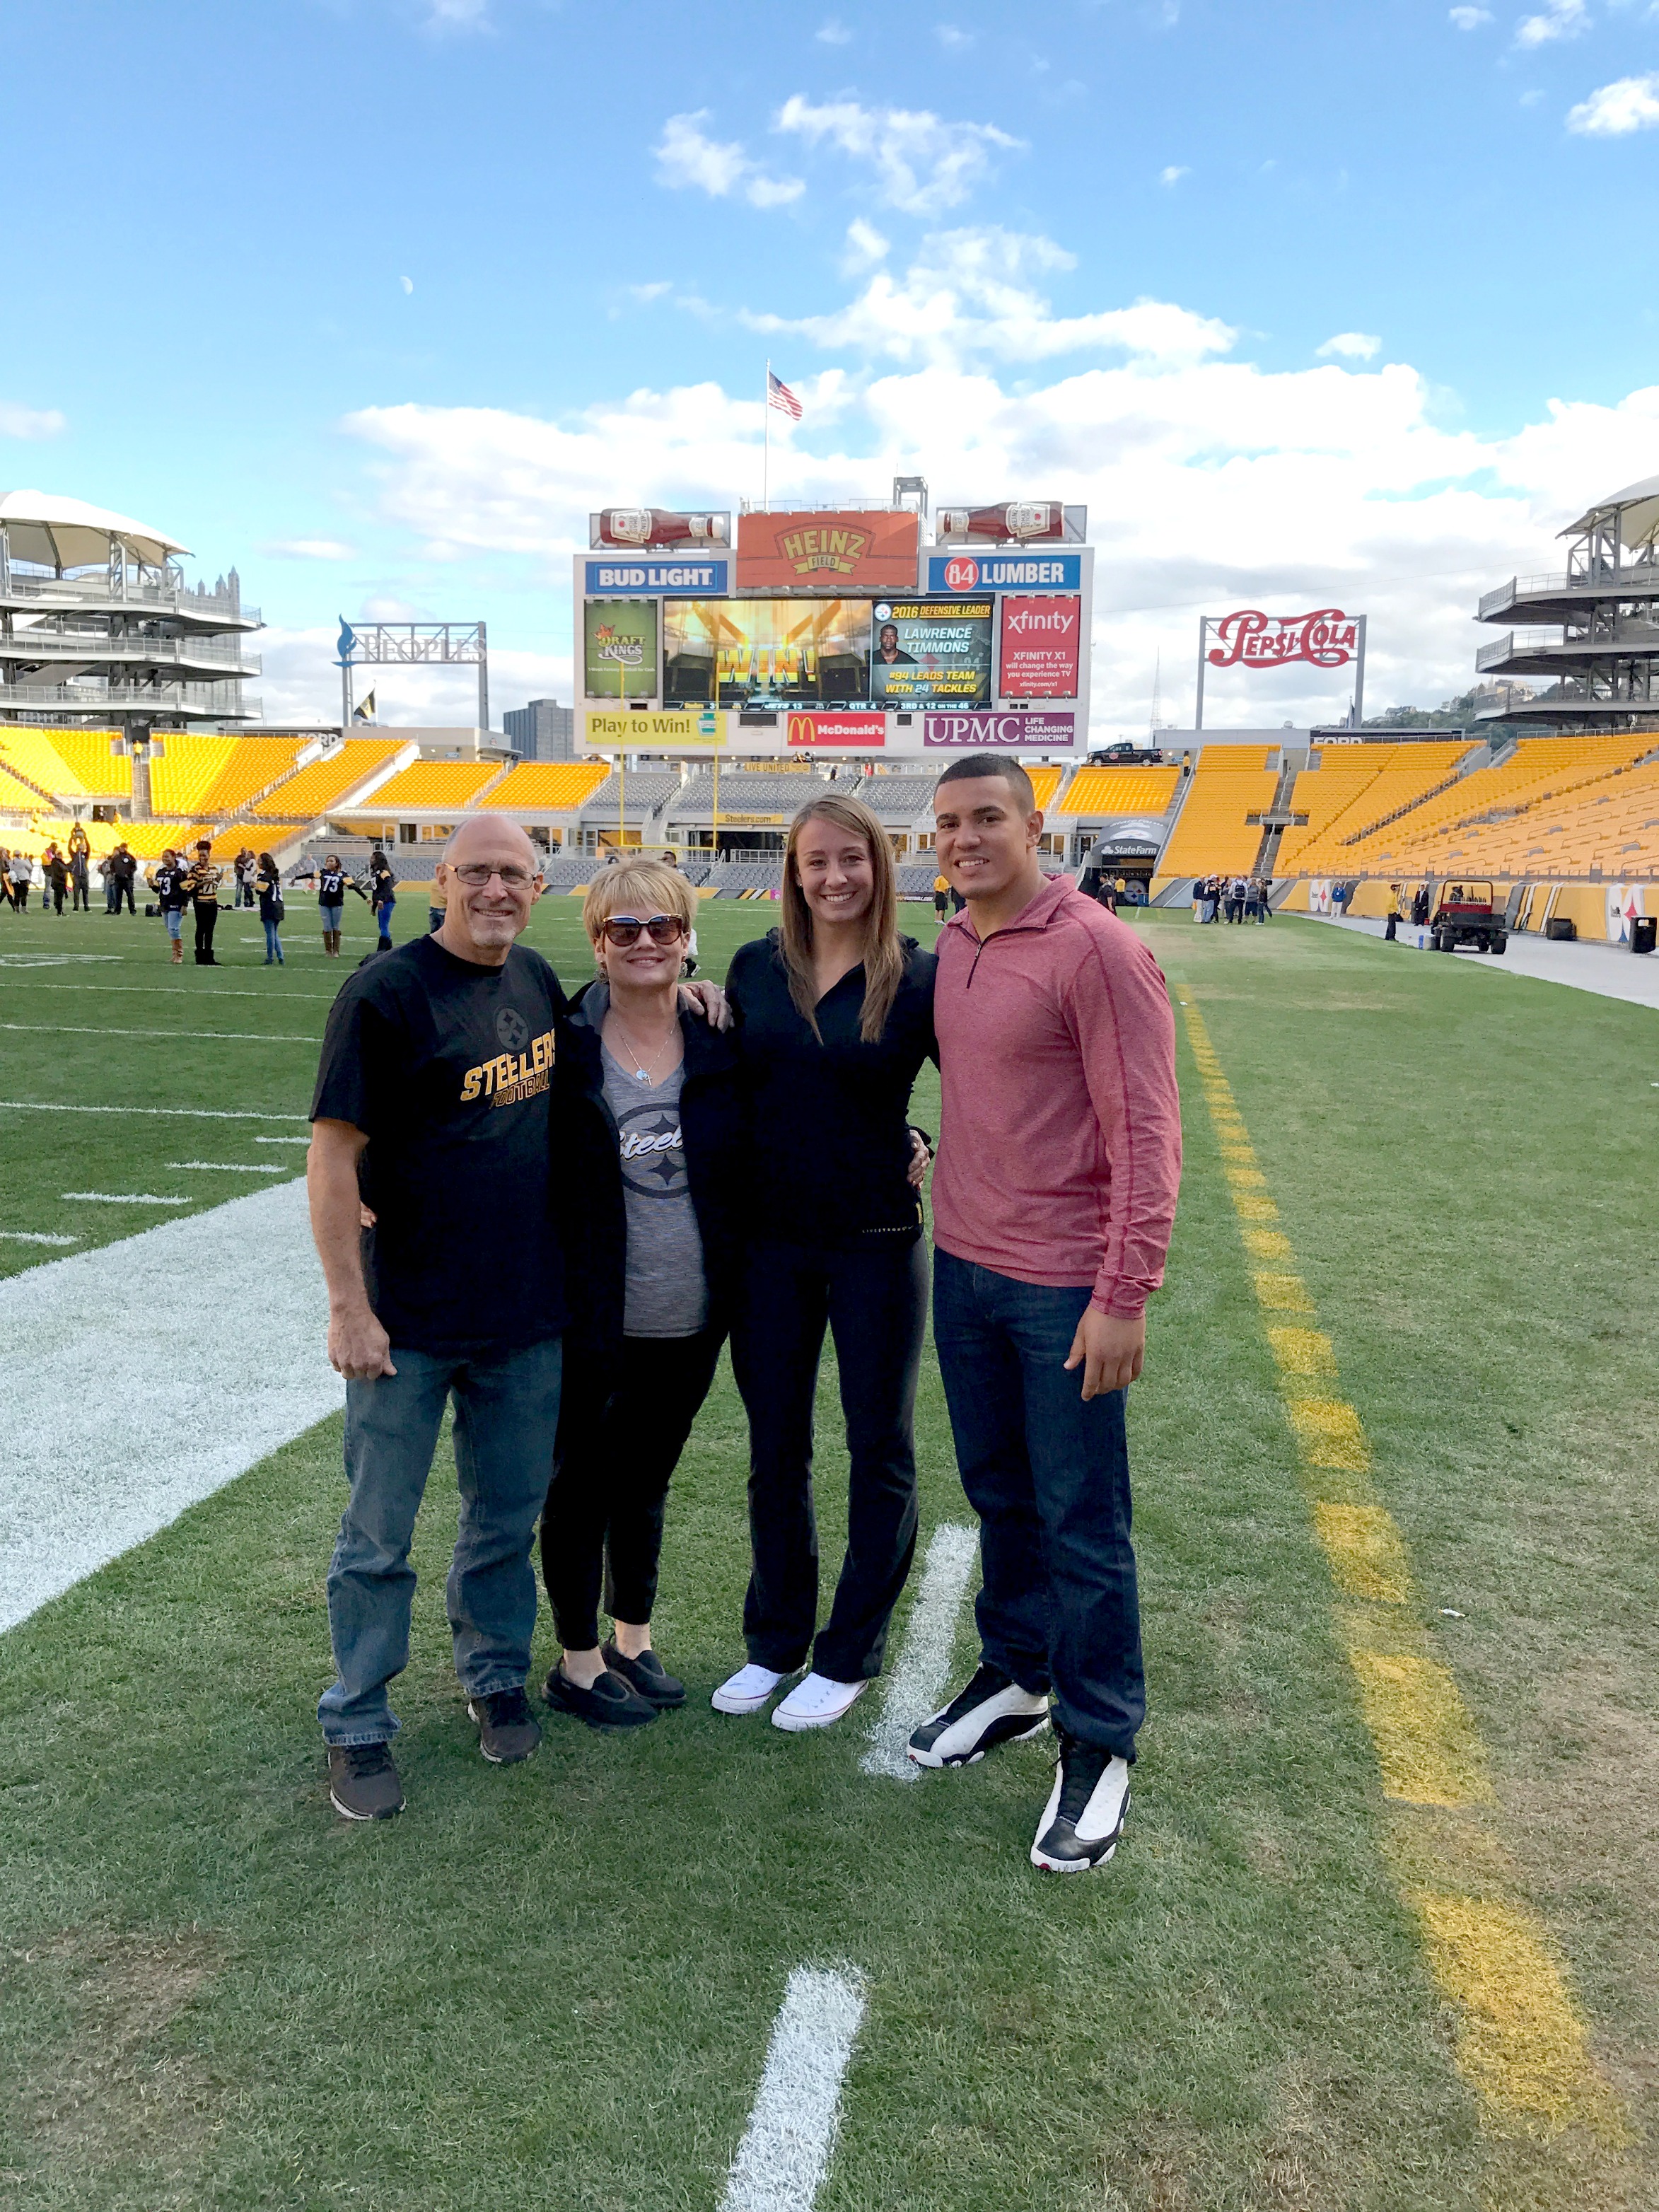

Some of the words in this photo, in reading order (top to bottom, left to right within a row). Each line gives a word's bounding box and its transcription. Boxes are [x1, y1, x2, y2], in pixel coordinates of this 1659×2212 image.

[784, 530, 865, 559] HEINZ
[812, 557, 836, 566] FIELD
[599, 569, 646, 586] BUD
[648, 569, 713, 586] LIGHT
[948, 564, 974, 584] 84
[982, 563, 1064, 584] LUMBER
[892, 606, 919, 619] 2016
[919, 605, 962, 615] DEFENSIVE
[962, 605, 991, 615] LEADER
[1008, 610, 1074, 634] xfinity
[598, 636, 645, 647] DRAFT
[904, 627, 973, 639] LAWRENCE
[363, 635, 487, 663] PEOPLES
[598, 644, 643, 662] KINGS
[907, 641, 970, 653] TIMMONS
[1013, 651, 1052, 660] XFINITY
[1054, 651, 1066, 660] X1
[717, 648, 816, 683] WIN!
[1019, 662, 1044, 670] change
[889, 671, 909, 680] #94
[911, 671, 943, 680] LEADS
[946, 671, 976, 680] TEAM
[885, 684, 913, 693] WITH
[915, 684, 929, 693] 24
[931, 684, 977, 693] TACKLES
[592, 718, 627, 737] Play
[631, 718, 648, 733] to
[653, 718, 690, 733] Win!
[817, 724, 885, 735] McDonald's
[926, 717, 1020, 743] UPMC
[745, 763, 760, 772] LIVE
[763, 763, 790, 772] UNITED
[725, 814, 772, 823] Steelers.com
[157, 876, 171, 895] 73
[322, 875, 340, 892] 73
[488, 1070, 550, 1110] FOOTBALL
[619, 1124, 683, 1160] teel
